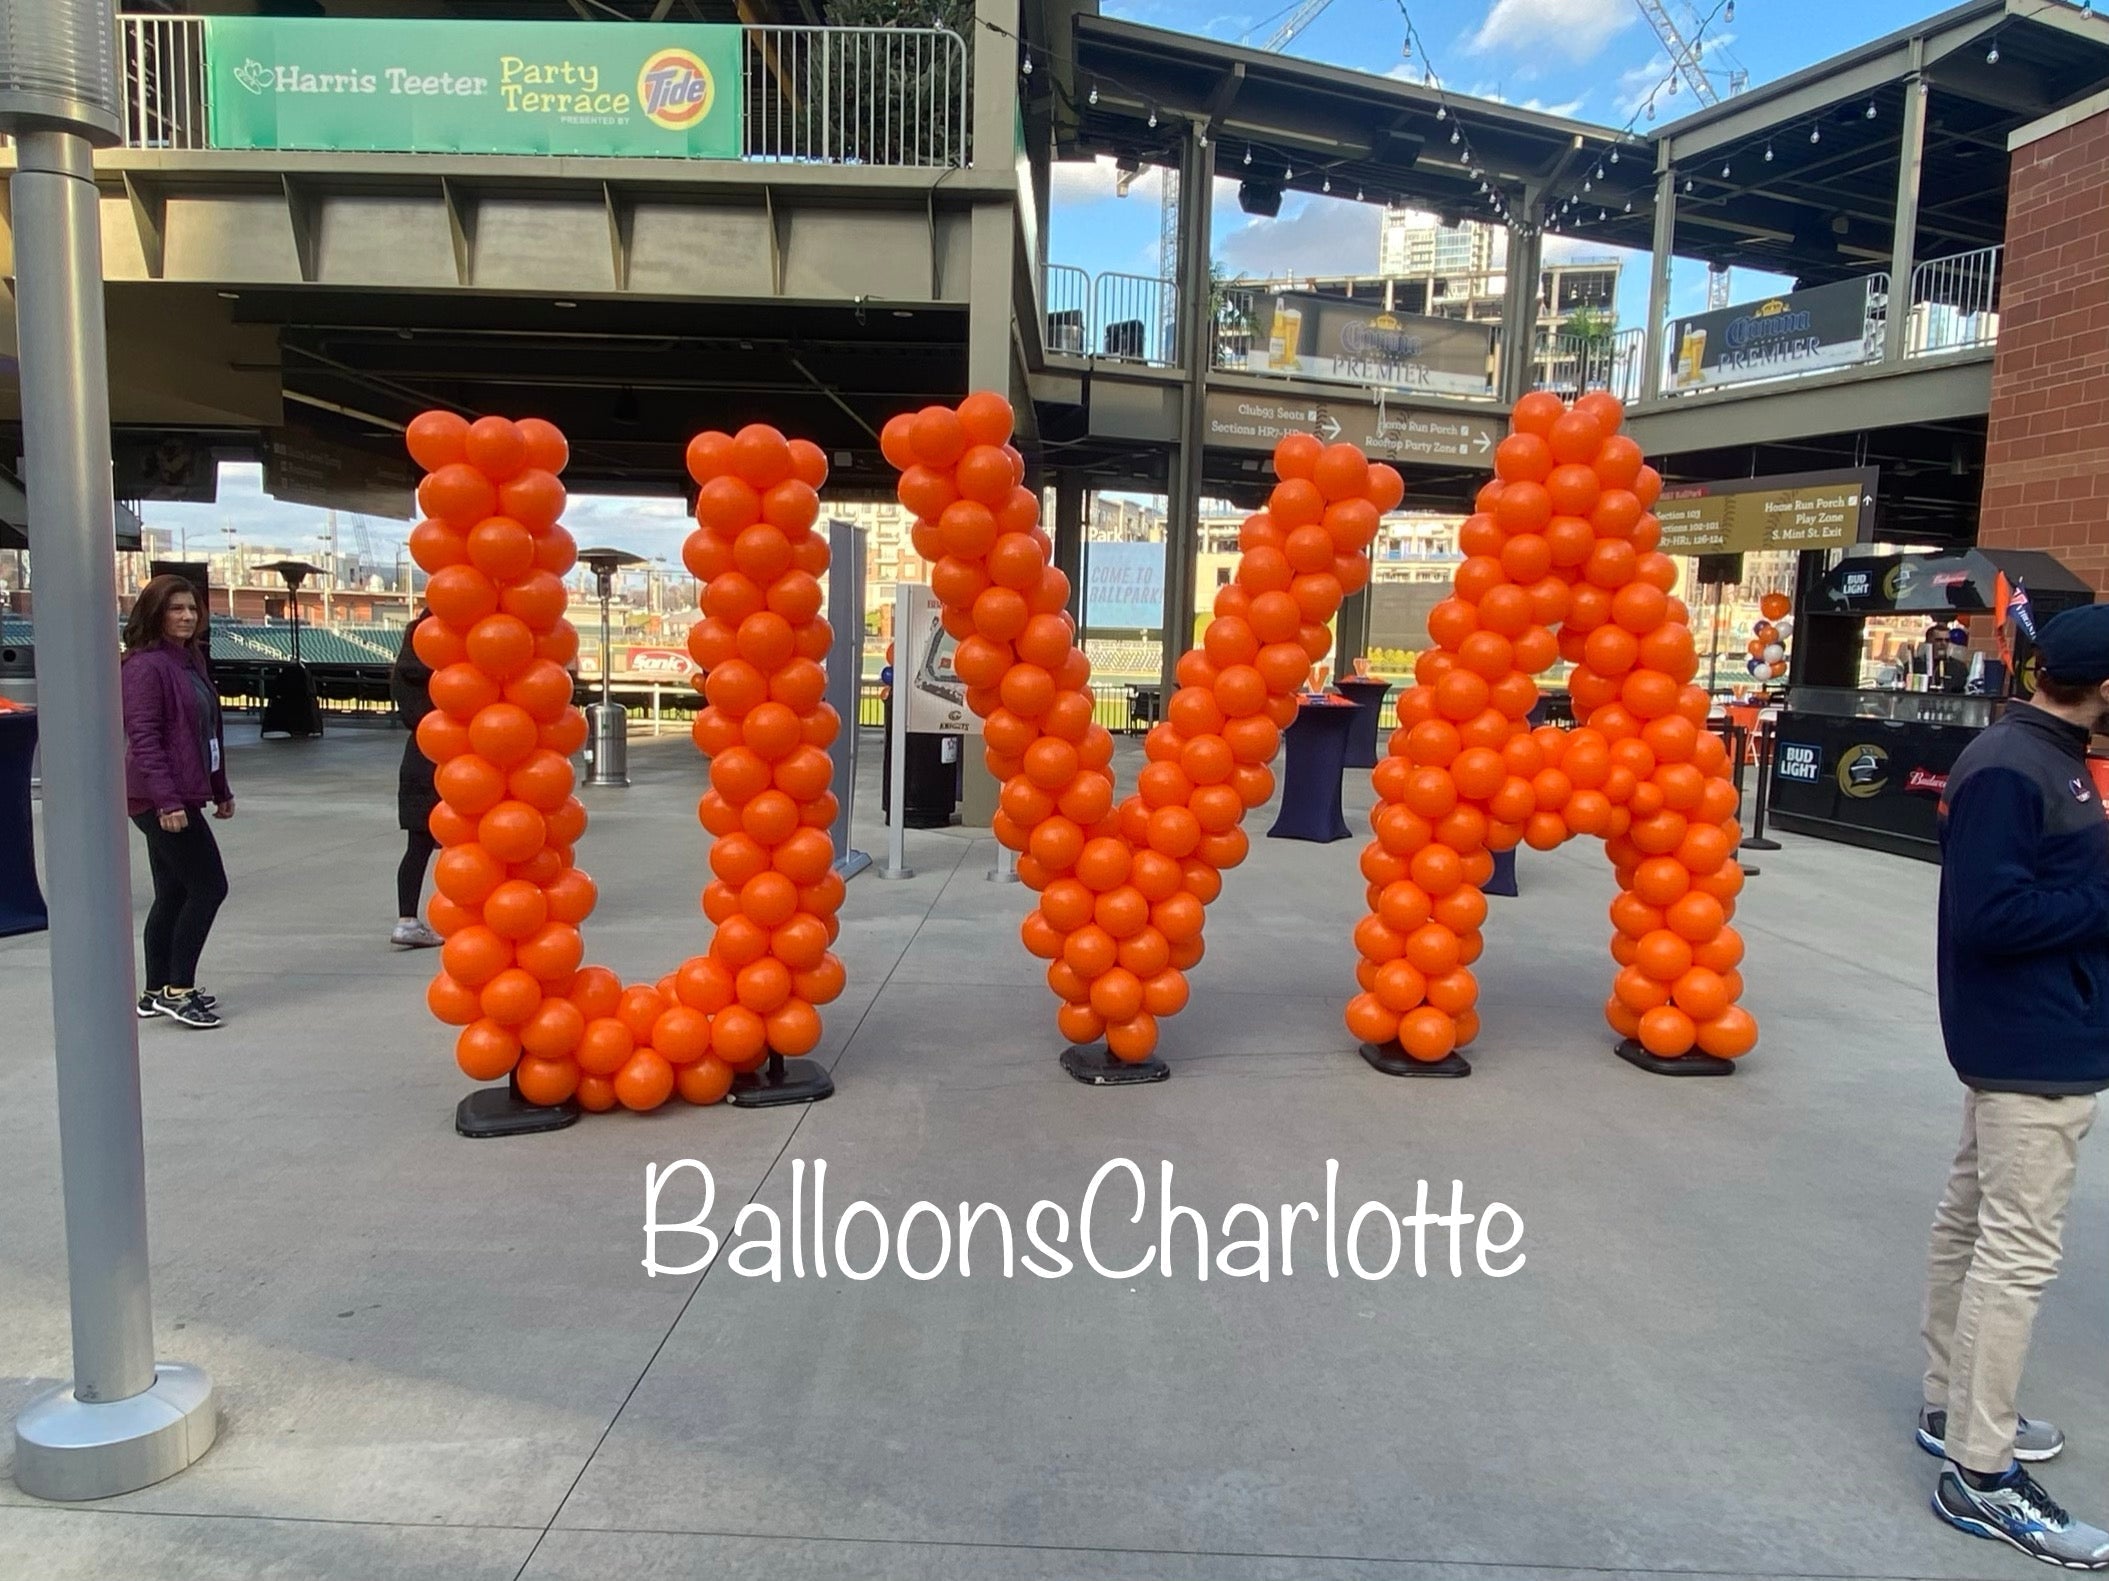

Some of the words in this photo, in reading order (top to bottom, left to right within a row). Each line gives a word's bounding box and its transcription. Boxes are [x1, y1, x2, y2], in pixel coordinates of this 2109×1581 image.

[274, 65, 377, 93] Harris
[384, 67, 488, 96] Teeter
[500, 56, 598, 92] Party
[500, 84, 630, 113] Terrace
[644, 67, 706, 116] Tide
[560, 116, 615, 125] PRESENTED
[617, 117, 630, 125] BY
[1717, 336, 1820, 373] PREMIER
[1331, 353, 1430, 385] PREMIER
[1238, 404, 1275, 420] Club93
[1211, 420, 1256, 437] Sections
[1408, 421, 1429, 433] Run
[1430, 423, 1458, 436] Porch
[1365, 436, 1403, 451] Rooftop
[1404, 439, 1432, 454] Party
[1434, 442, 1457, 454] Zone
[1764, 501, 1793, 513] Home
[1795, 499, 1814, 511] Run
[1816, 495, 1845, 509] Porch
[1795, 512, 1816, 526] Play
[1818, 512, 1844, 524] Zone
[1782, 528, 1805, 540] Mint
[1822, 525, 1842, 538] Exit
[1847, 573, 1867, 585] BUD
[1843, 583, 1870, 595] LIGHT
[1786, 747, 1814, 763] BUD
[1780, 760, 1818, 779] LIGHT
